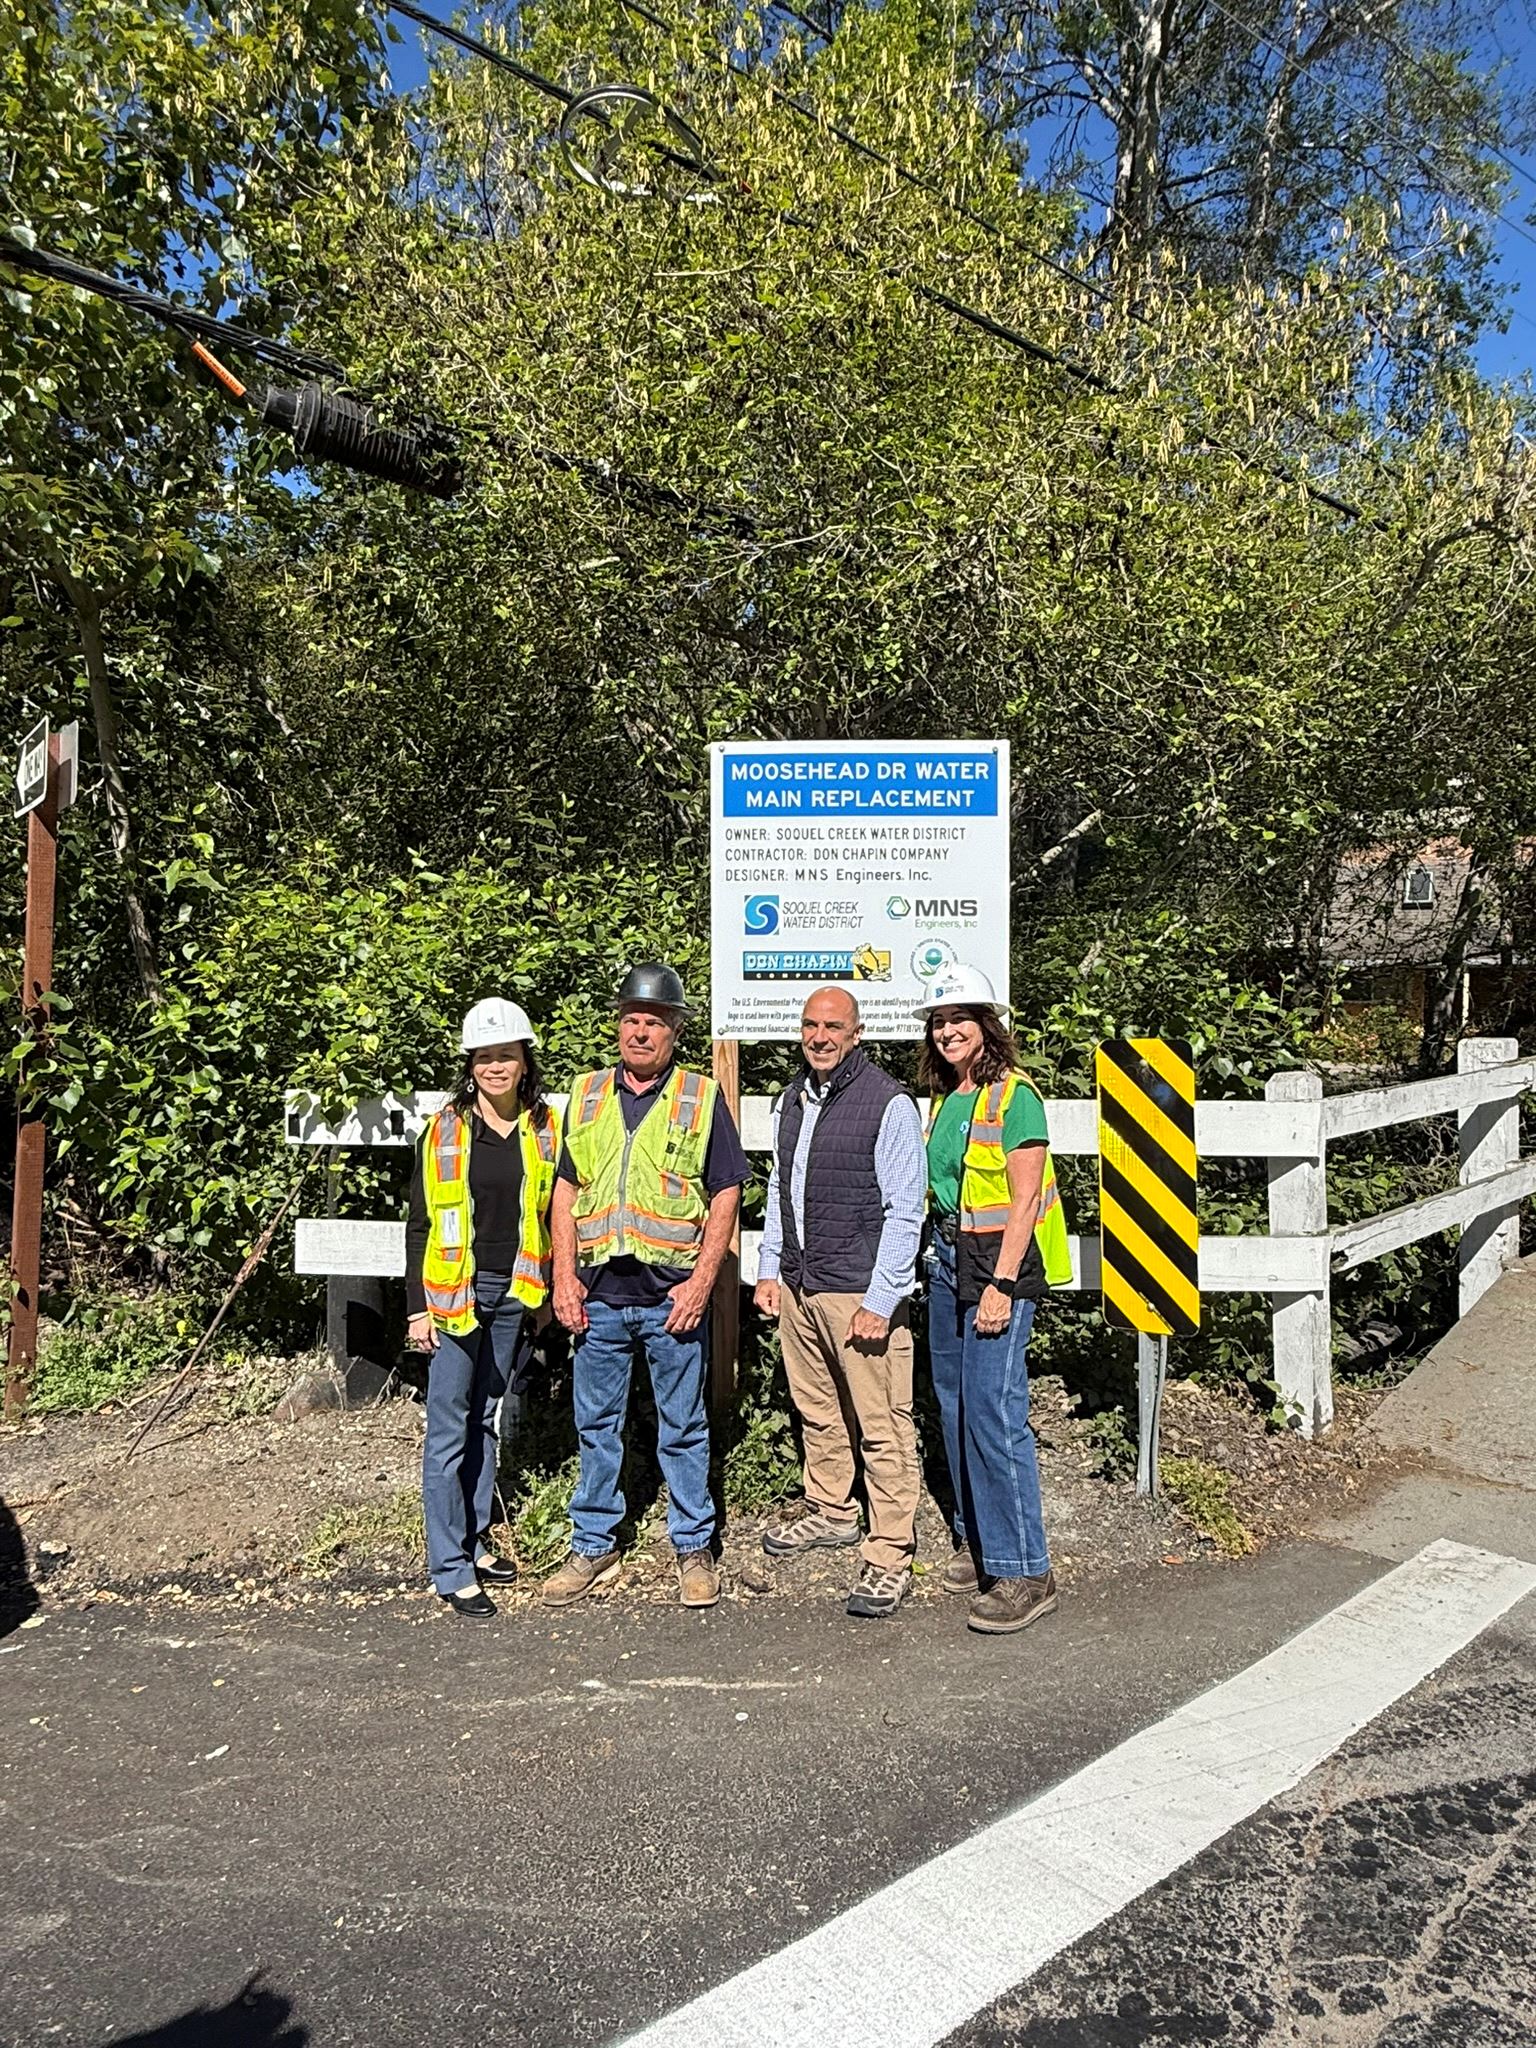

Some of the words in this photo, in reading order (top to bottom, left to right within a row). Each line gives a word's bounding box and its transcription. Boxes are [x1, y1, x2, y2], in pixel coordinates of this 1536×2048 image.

[732, 762, 870, 780] MOOSEHEAD
[877, 762, 906, 779] DR
[915, 762, 989, 779] WATER
[746, 790, 801, 807] MAIN
[811, 790, 975, 807] REPLACEMENT
[725, 828, 770, 841] OWNER:
[776, 828, 825, 841] SOQUEL
[828, 828, 867, 840] CREEK
[870, 828, 909, 840] WATER
[913, 827, 966, 840] DISTRICT
[725, 848, 807, 861] CONTRACTOR:
[814, 848, 839, 860] DON
[842, 848, 887, 860] CHAPIN
[891, 848, 950, 860] COMPANY
[725, 869, 789, 882] DESIGNER:
[909, 868, 932, 881] Inc.
[782, 901, 822, 914] SOQUEL
[824, 901, 859, 914] CREEK
[915, 899, 978, 917] MNS
[783, 916, 817, 928] WATER
[819, 915, 864, 928] DISTRICT
[964, 919, 978, 928] Inc
[746, 954, 781, 969] DON
[783, 954, 849, 969] CHAPIN
